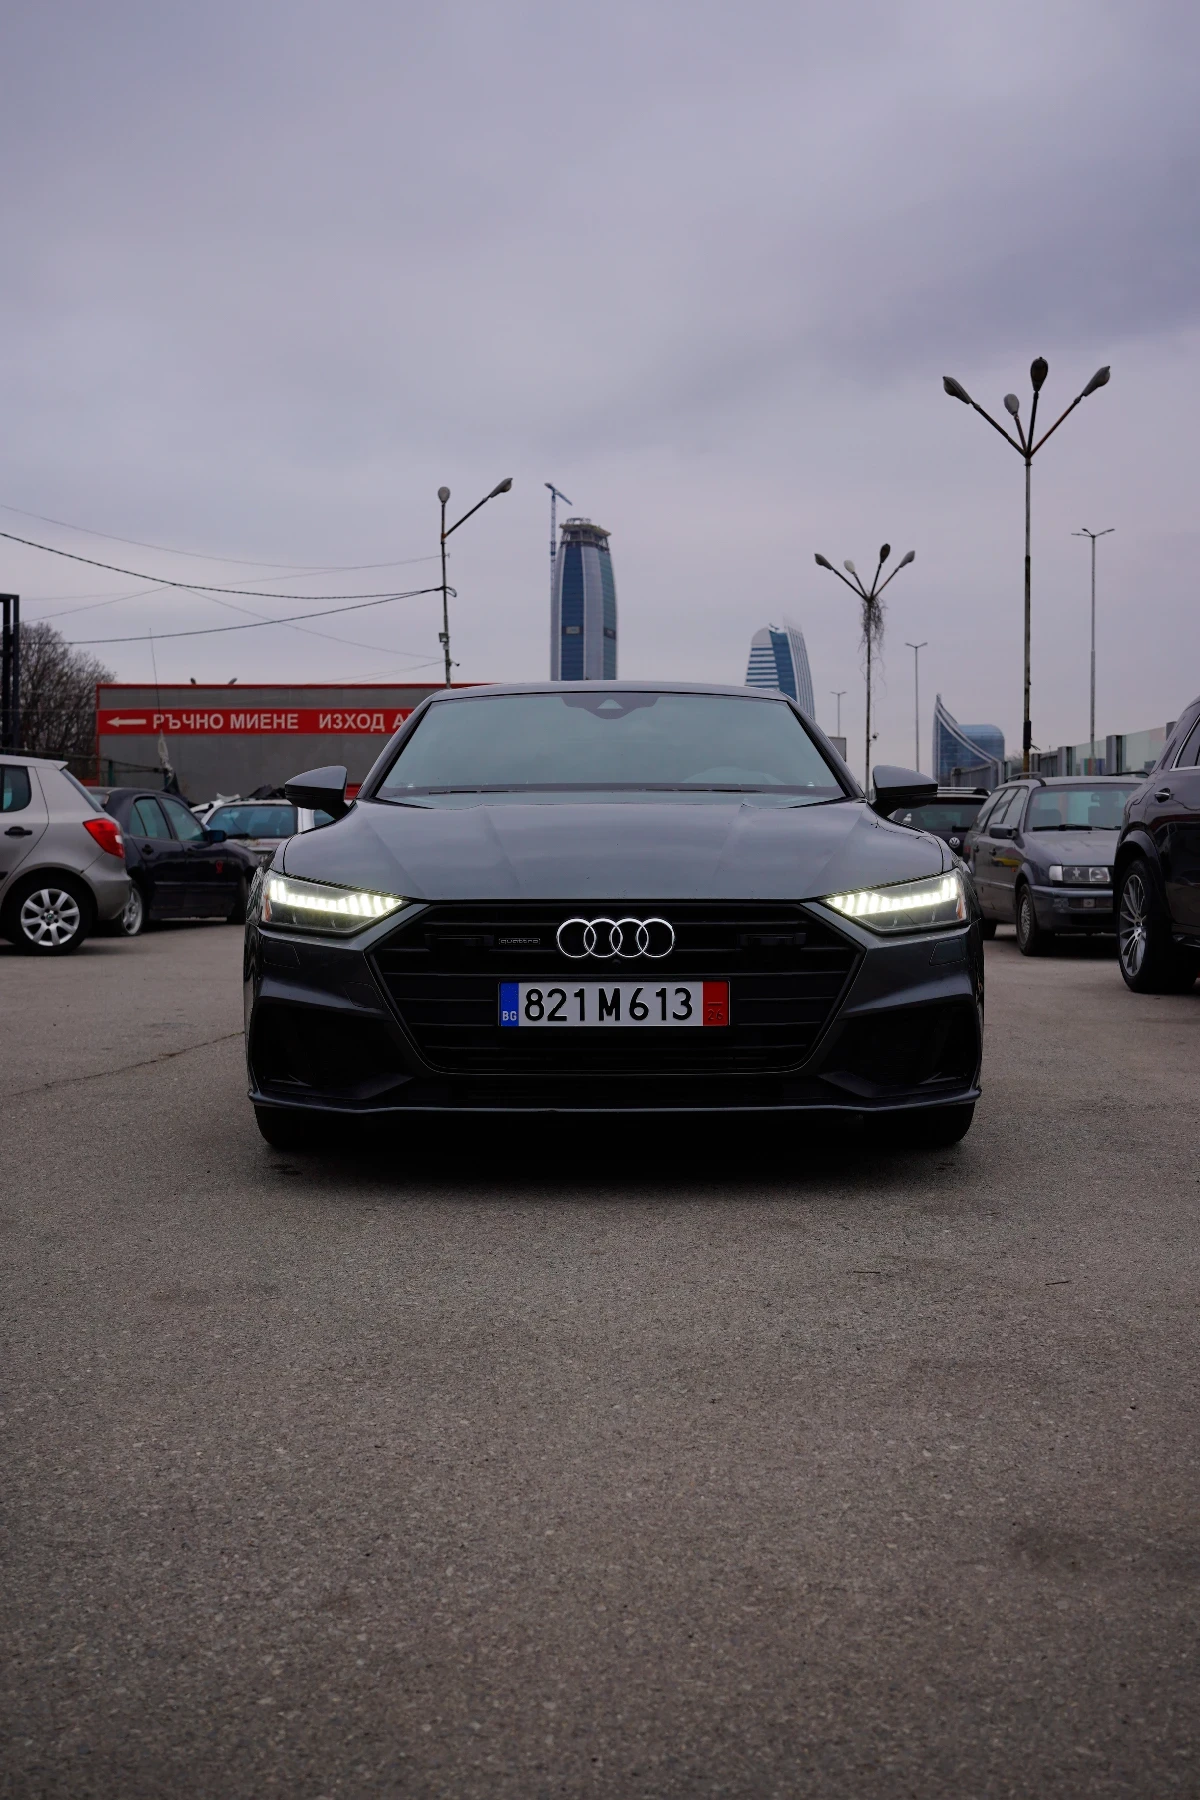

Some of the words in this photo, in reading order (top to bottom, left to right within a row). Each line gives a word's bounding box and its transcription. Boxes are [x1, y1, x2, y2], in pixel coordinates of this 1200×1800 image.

[153, 713, 224, 729] РЪЧНО
[230, 713, 299, 729] МИЕНЕ
[319, 713, 385, 732] ИЗХОД
[502, 1010, 517, 1021] BG
[707, 1008, 724, 1021] 26
